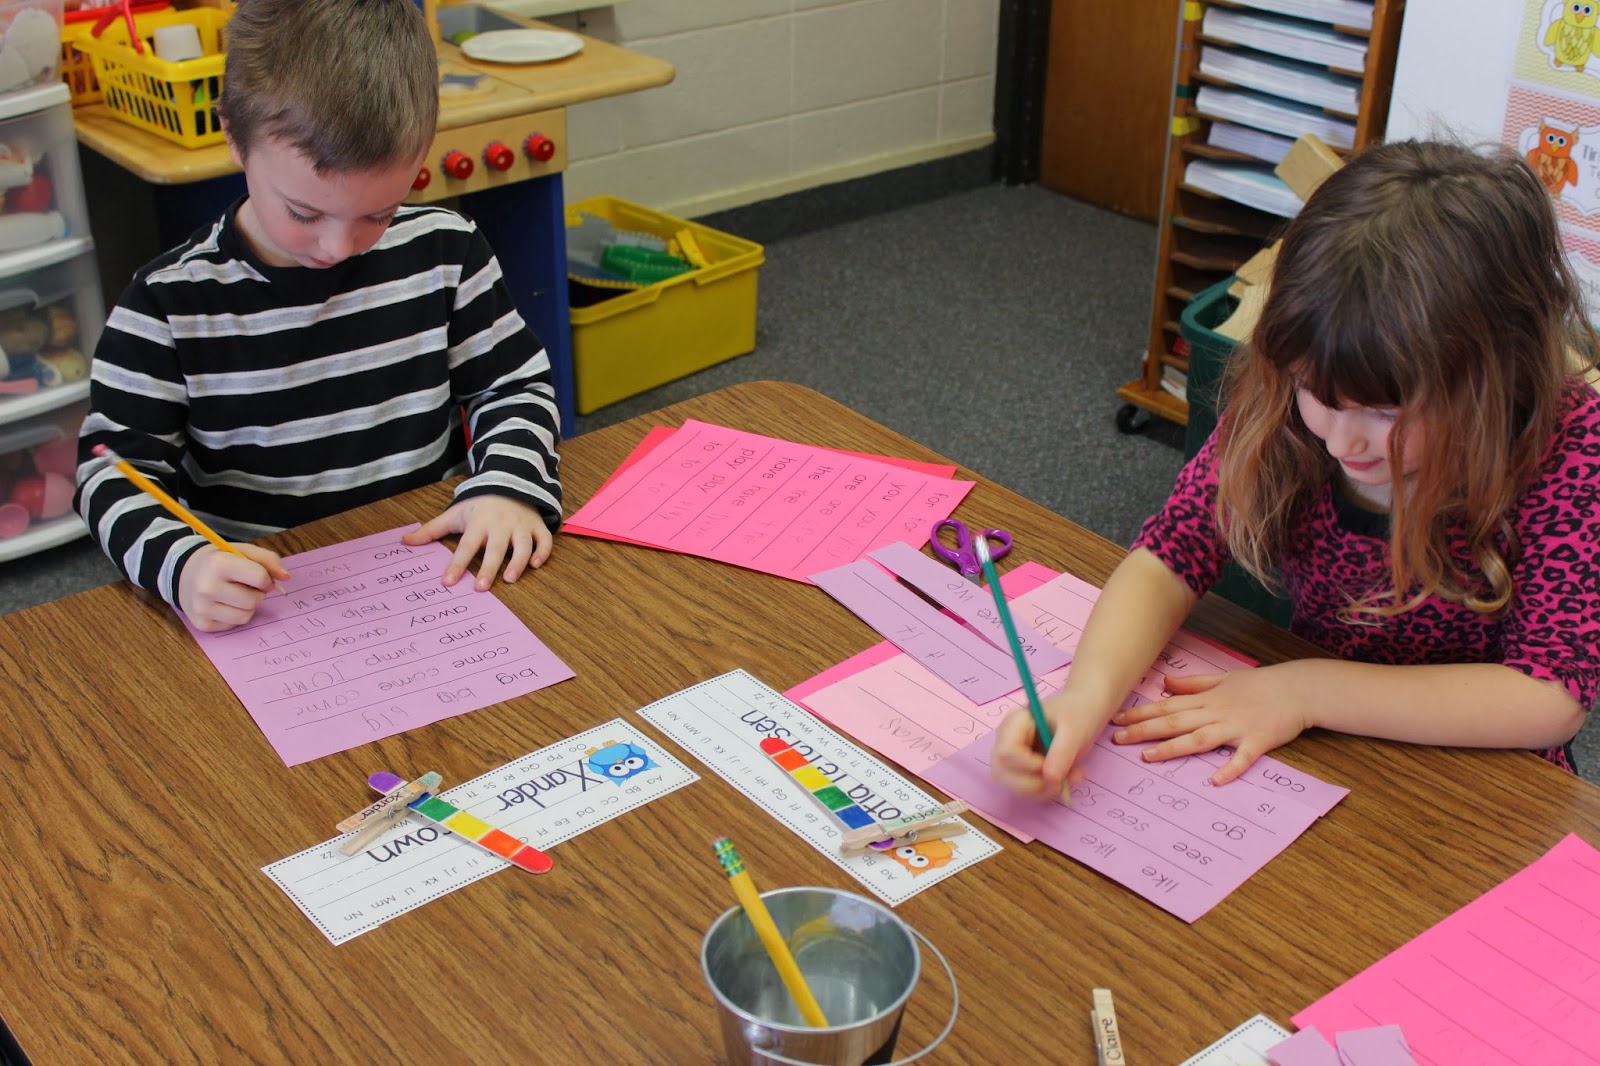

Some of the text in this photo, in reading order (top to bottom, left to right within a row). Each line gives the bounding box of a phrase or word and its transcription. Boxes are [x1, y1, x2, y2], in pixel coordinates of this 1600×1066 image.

[702, 441, 723, 452] to
[680, 459, 700, 469] to
[724, 447, 756, 470] play
[762, 457, 798, 480] have
[808, 465, 834, 481] the
[696, 473, 726, 494] play
[844, 474, 867, 491] are
[731, 485, 766, 507] have
[783, 489, 808, 504] the
[882, 482, 906, 502] you
[819, 499, 842, 516] are
[856, 508, 880, 528] you
[374, 547, 414, 561] two
[377, 564, 431, 586] make
[312, 581, 367, 603] make
[405, 585, 452, 603] help
[341, 602, 390, 620] help
[410, 605, 468, 628] away
[438, 622, 488, 645] jump
[1033, 612, 1074, 647] ith
[332, 627, 388, 649] away
[364, 641, 420, 667] jump
[451, 646, 510, 669] come
[924, 651, 946, 660] it
[377, 667, 440, 692] come
[495, 668, 539, 685] big
[960, 675, 981, 685] it
[436, 687, 477, 708] big
[753, 692, 765, 701] Zz
[766, 701, 779, 711] Yy
[667, 711, 681, 722] Nn
[781, 710, 794, 720] Xx
[682, 722, 700, 737] Mm
[797, 721, 814, 735] Ww
[568, 743, 587, 754] Oo
[713, 744, 727, 755] Kk
[816, 737, 830, 747] Vv
[546, 752, 563, 763] Pp
[833, 748, 848, 759] Uu
[519, 762, 541, 774] Qq
[849, 759, 861, 768] Tt
[502, 773, 516, 782] Rr
[646, 774, 664, 786] Aa
[864, 768, 876, 778] Ss
[483, 781, 497, 791] Ss
[754, 775, 770, 787] Hh
[877, 779, 892, 789] Rr
[1262, 769, 1306, 793] can
[465, 790, 479, 799] Tt
[625, 784, 642, 795] Bb
[771, 787, 788, 802] Gg
[893, 788, 911, 803] Qq
[360, 792, 403, 821] Xander
[600, 795, 620, 807] Cc
[788, 802, 803, 812] Ff
[847, 783, 902, 821] ofia
[1157, 794, 1190, 811] go
[365, 759, 604, 864] Xander own
[575, 806, 596, 818] Dd
[804, 812, 819, 824] Ee
[901, 806, 945, 825] Sofia
[1257, 803, 1276, 818] is
[554, 816, 572, 828] Ee
[1106, 808, 1150, 833] see
[536, 827, 549, 837] Ff
[822, 824, 839, 838] Dd
[1211, 821, 1247, 840] go
[319, 851, 336, 860] Zz
[1172, 842, 1213, 866] see
[1079, 834, 1180, 894] like like
[421, 875, 439, 887] Kk
[878, 868, 897, 882] Aa
[371, 894, 397, 910] Mm
[343, 910, 364, 922] Nn
[1102, 1018, 1121, 1060] Claire
